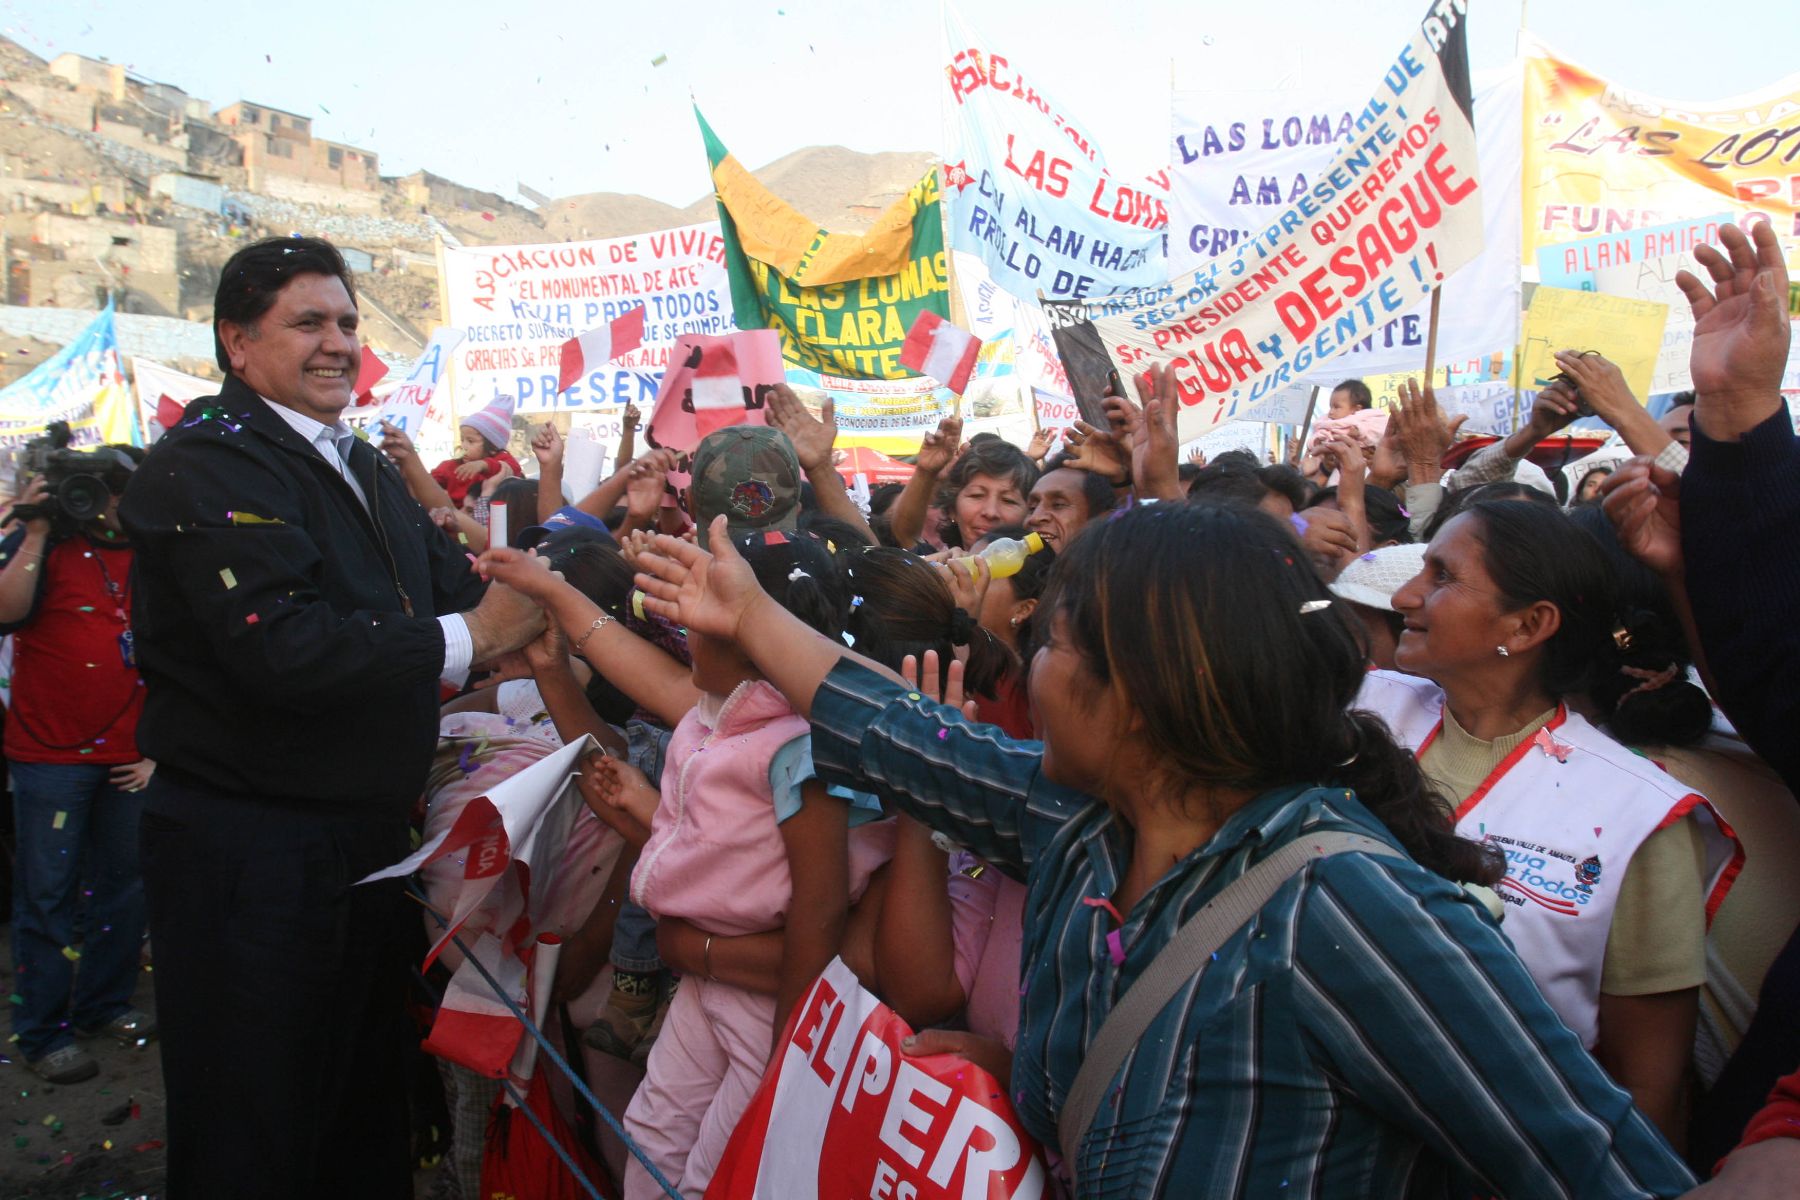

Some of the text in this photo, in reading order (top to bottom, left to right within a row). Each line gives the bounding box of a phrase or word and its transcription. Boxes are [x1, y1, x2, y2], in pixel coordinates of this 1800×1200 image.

[1384, 43, 1424, 96] DE
[1176, 122, 1246, 164] LAS
[1261, 112, 1354, 150] LOMA
[1004, 134, 1072, 198] LAS
[1089, 177, 1168, 231] LOMA
[1228, 173, 1309, 205] AMA
[1014, 206, 1085, 260] ALAN
[1153, 243, 1308, 350] PRESIDENTE
[1310, 106, 1441, 246] QUEREMOS
[609, 241, 637, 264] DE
[1564, 238, 1632, 275] ALAN
[1637, 253, 1695, 290] ALA
[541, 273, 640, 299] MONUMENTAL
[643, 269, 663, 292] DE
[859, 251, 949, 308] LOMAS
[1052, 268, 1095, 299] DE
[1142, 328, 1263, 411] GUA
[1274, 143, 1478, 344] DESAGUE
[652, 289, 719, 320] TODOS
[1131, 278, 1219, 330] SECTOR
[468, 323, 522, 342] DECRETO
[643, 325, 659, 342] UE
[664, 322, 678, 339] SE
[796, 307, 905, 346] CLARA
[1248, 276, 1404, 402] URGENTE
[465, 347, 518, 371] GRACIAS
[640, 347, 671, 367] ALA
[834, 416, 879, 428] ECONOCIDO
[1519, 868, 1591, 905] todos
[792, 977, 1021, 1200] EL PER
